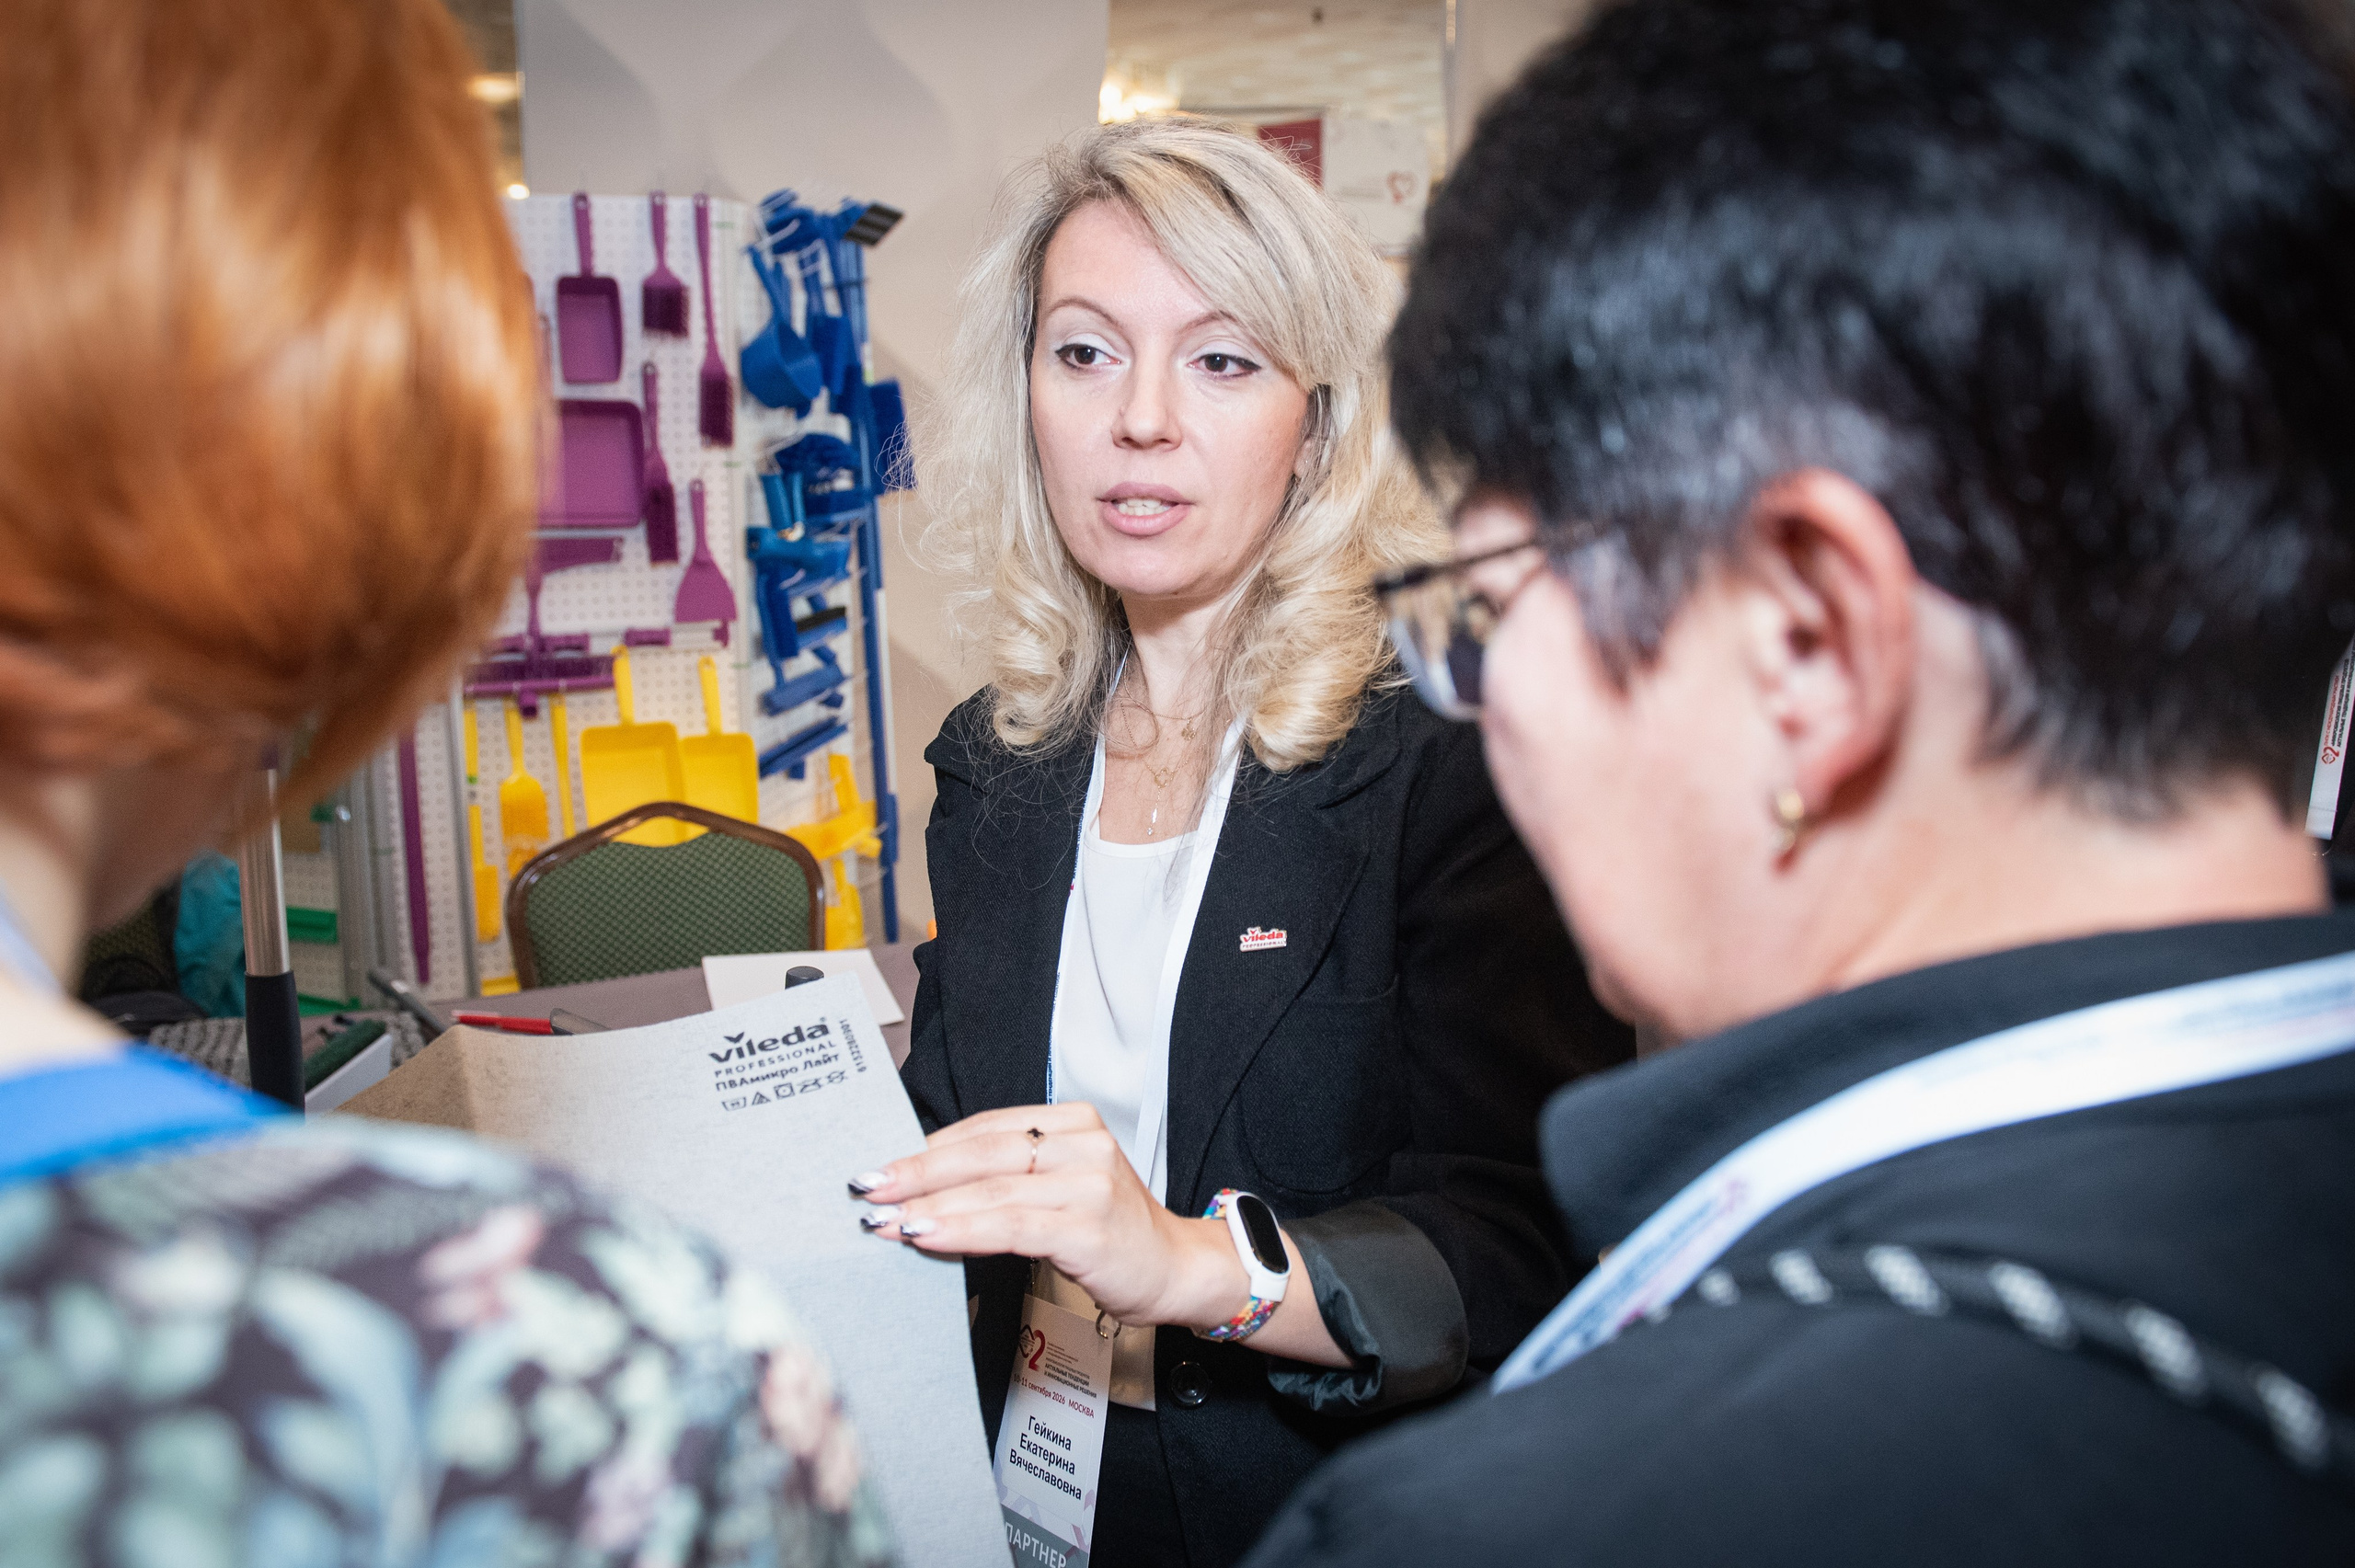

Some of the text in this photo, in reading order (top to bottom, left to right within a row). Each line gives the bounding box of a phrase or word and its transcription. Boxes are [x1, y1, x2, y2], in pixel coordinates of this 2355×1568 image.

[715, 1040, 836, 1078] PROFESSIONAL
[716, 1053, 840, 1092] ПВАмикро Лайт
[1028, 1381, 1051, 1399] сентября
[1068, 1399, 1095, 1418] МОСКВА
[1028, 1415, 1072, 1451] Гейкина
[1019, 1433, 1075, 1475] Екатерина
[1009, 1448, 1082, 1500] Вячеславовна
